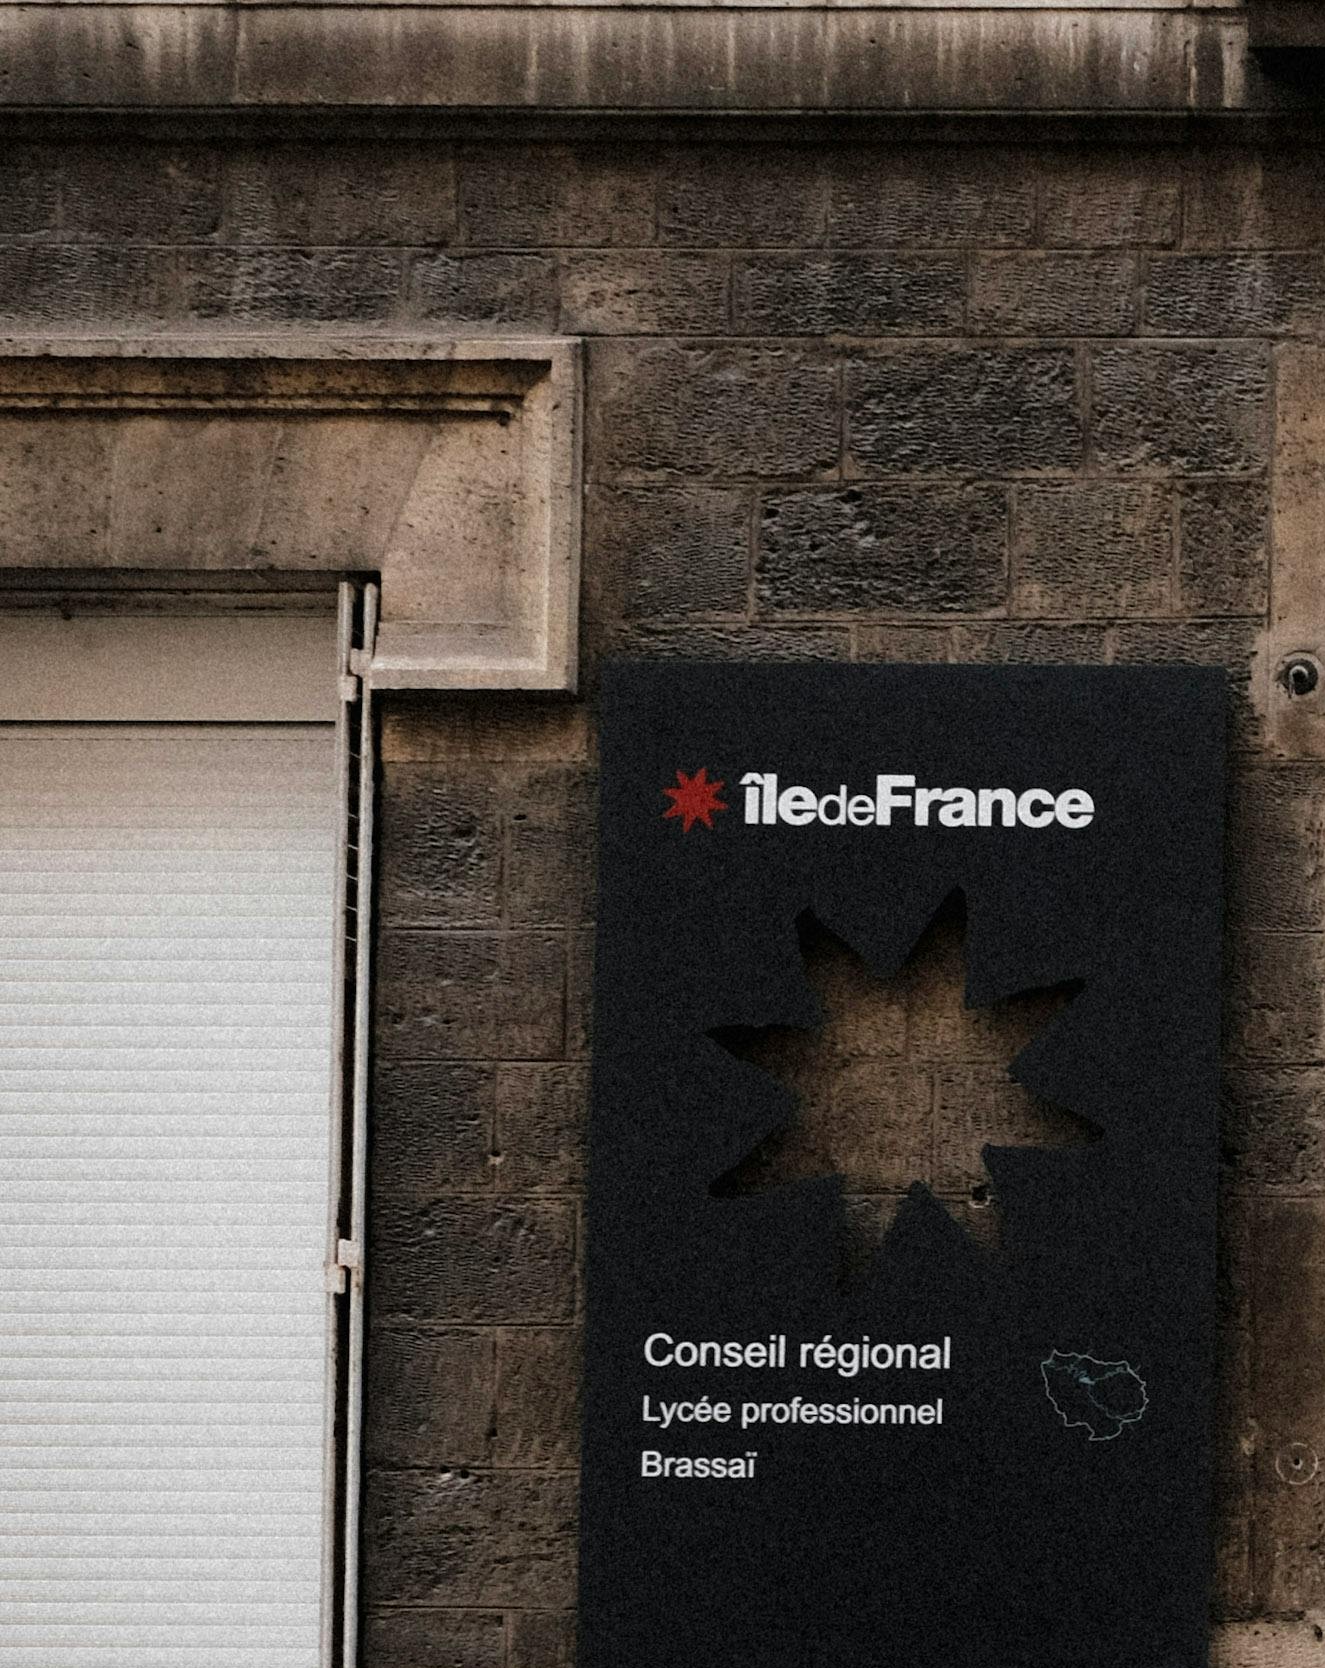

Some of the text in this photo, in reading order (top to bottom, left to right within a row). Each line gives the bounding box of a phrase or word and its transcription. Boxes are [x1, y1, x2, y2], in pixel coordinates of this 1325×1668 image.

[643, 1331, 952, 1379] Conseil régional
[641, 1394, 944, 1430] Lycée professionnel
[640, 1449, 759, 1480] Brassaï
